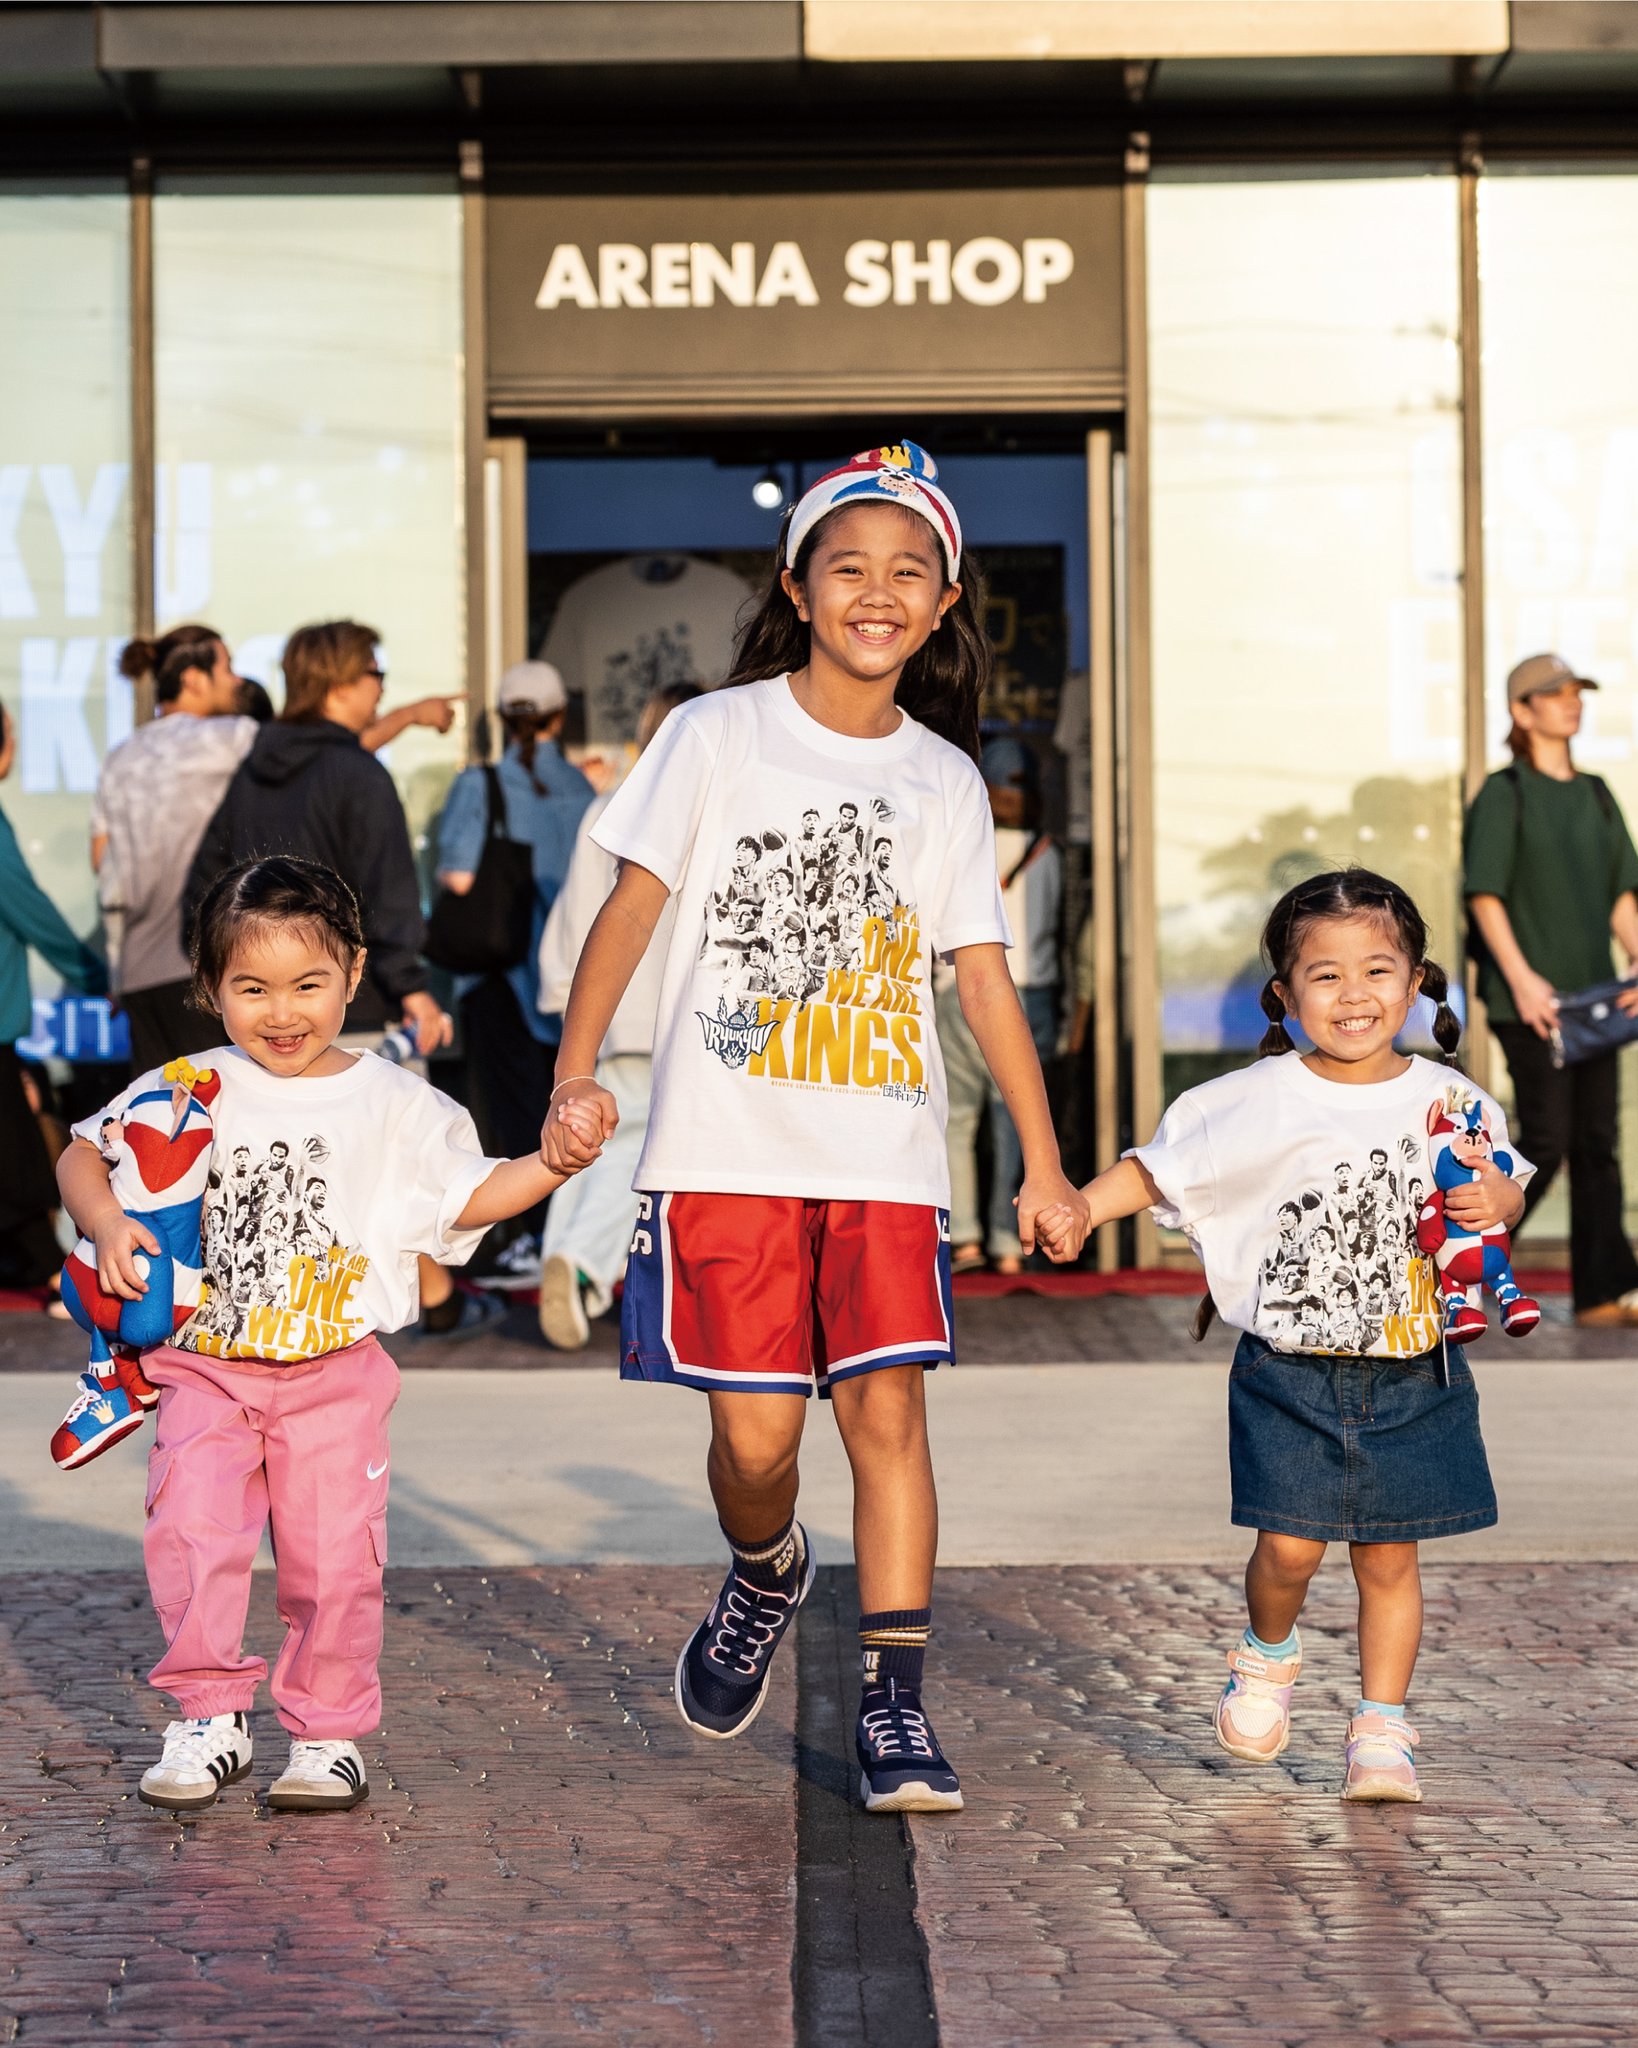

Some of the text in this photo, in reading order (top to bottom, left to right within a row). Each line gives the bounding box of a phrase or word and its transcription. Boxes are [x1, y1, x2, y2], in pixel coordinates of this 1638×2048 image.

[535, 236, 1075, 308] ARENA SHOP
[883, 1082, 927, 1108] 団結の力
[248, 1304, 299, 1349] WE
[299, 1316, 356, 1353] ARE
[1384, 1313, 1423, 1353] WE
